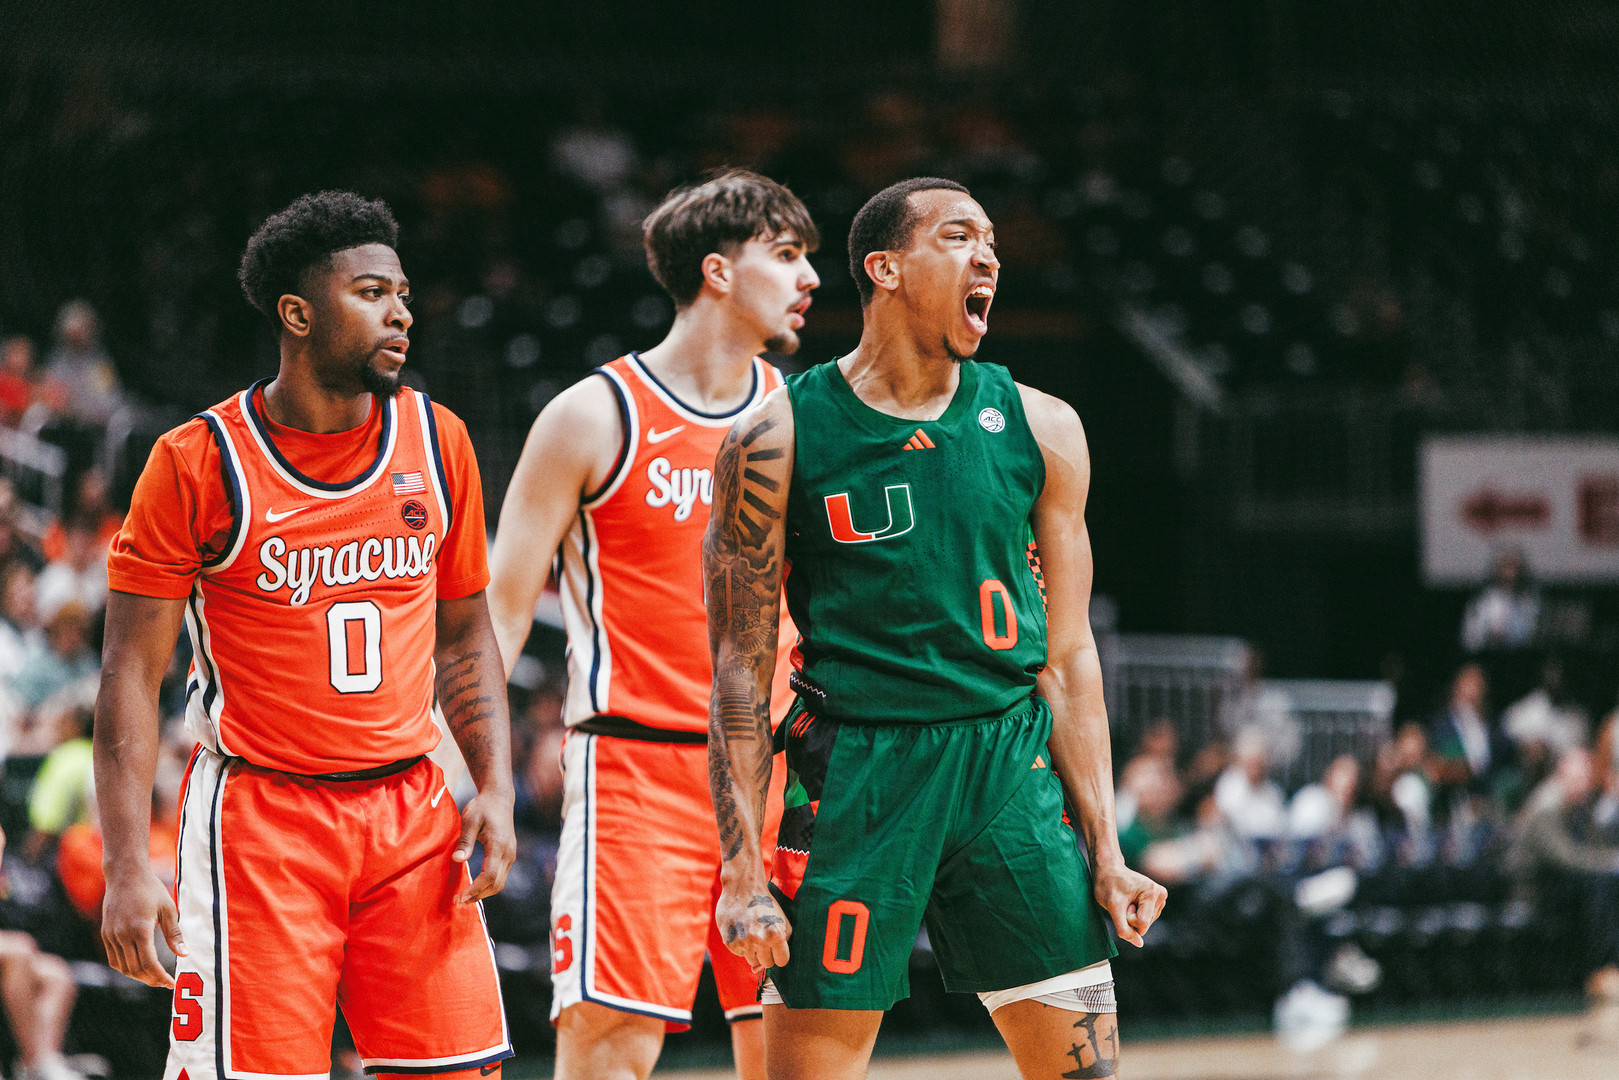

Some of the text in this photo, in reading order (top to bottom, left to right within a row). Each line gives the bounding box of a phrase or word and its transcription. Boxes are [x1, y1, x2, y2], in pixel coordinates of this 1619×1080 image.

[405, 509, 425, 517] ACC
[645, 456, 715, 522] Syr
[824, 483, 916, 543] U
[256, 532, 436, 606] Syracuse
[326, 600, 383, 695] 0
[979, 579, 1019, 651] 0
[822, 899, 870, 975] 0
[172, 972, 204, 1041] S
